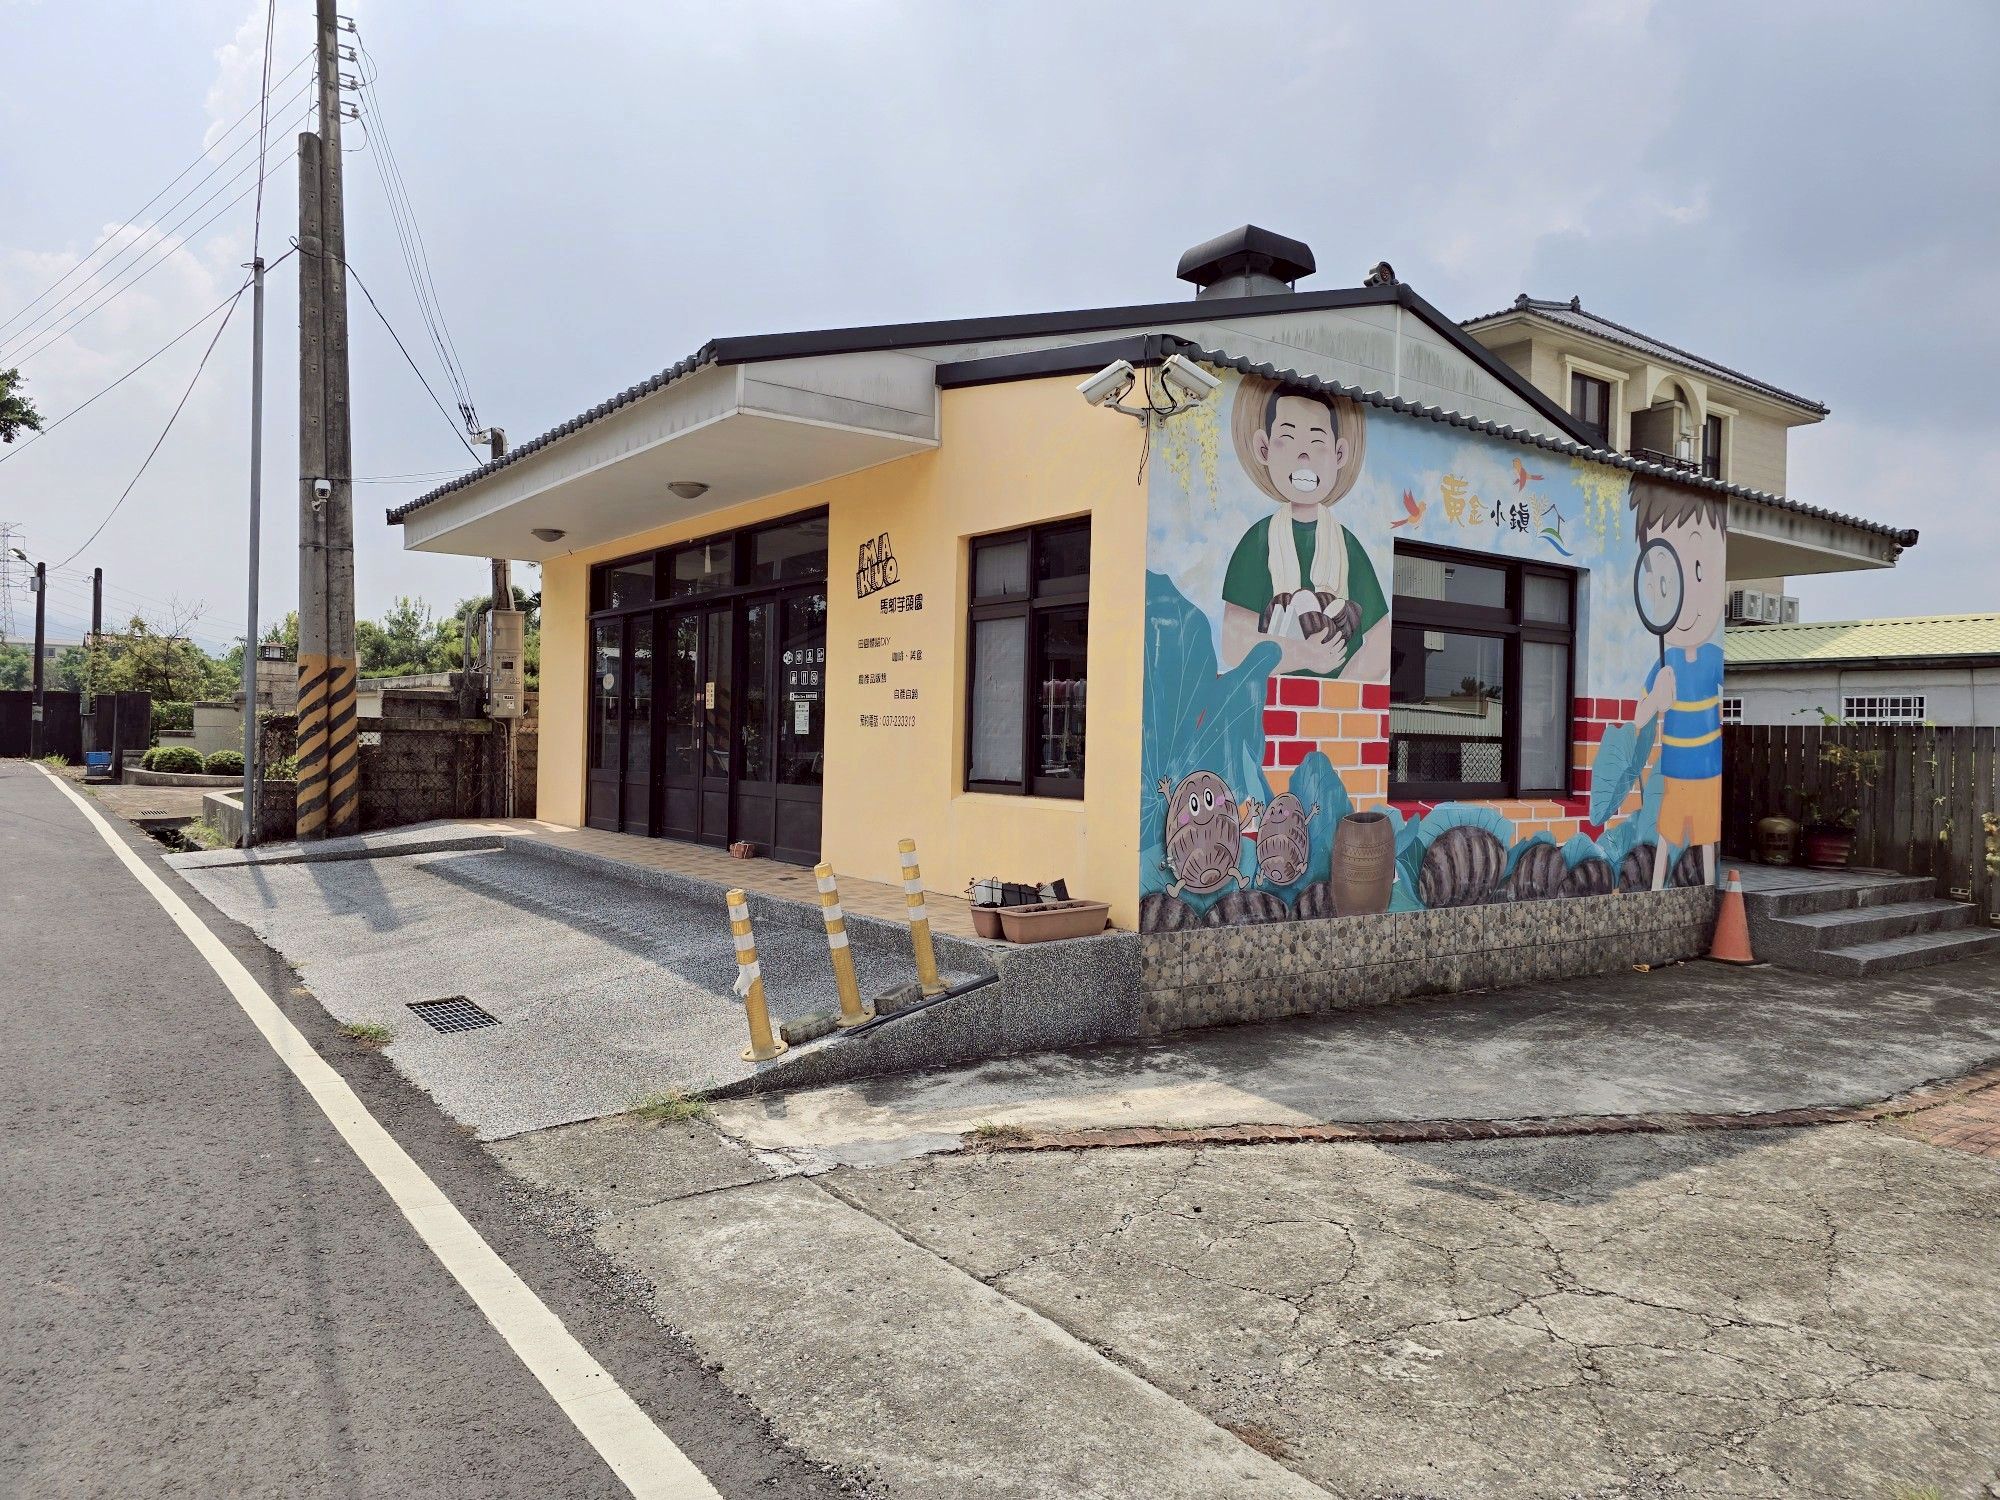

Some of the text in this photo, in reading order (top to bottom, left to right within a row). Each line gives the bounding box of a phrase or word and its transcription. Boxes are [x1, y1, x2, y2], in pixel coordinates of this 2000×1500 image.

[1440, 473, 1531, 534] 黃金小鎮
[859, 532, 893, 572] MA
[856, 556, 900, 599] KUO
